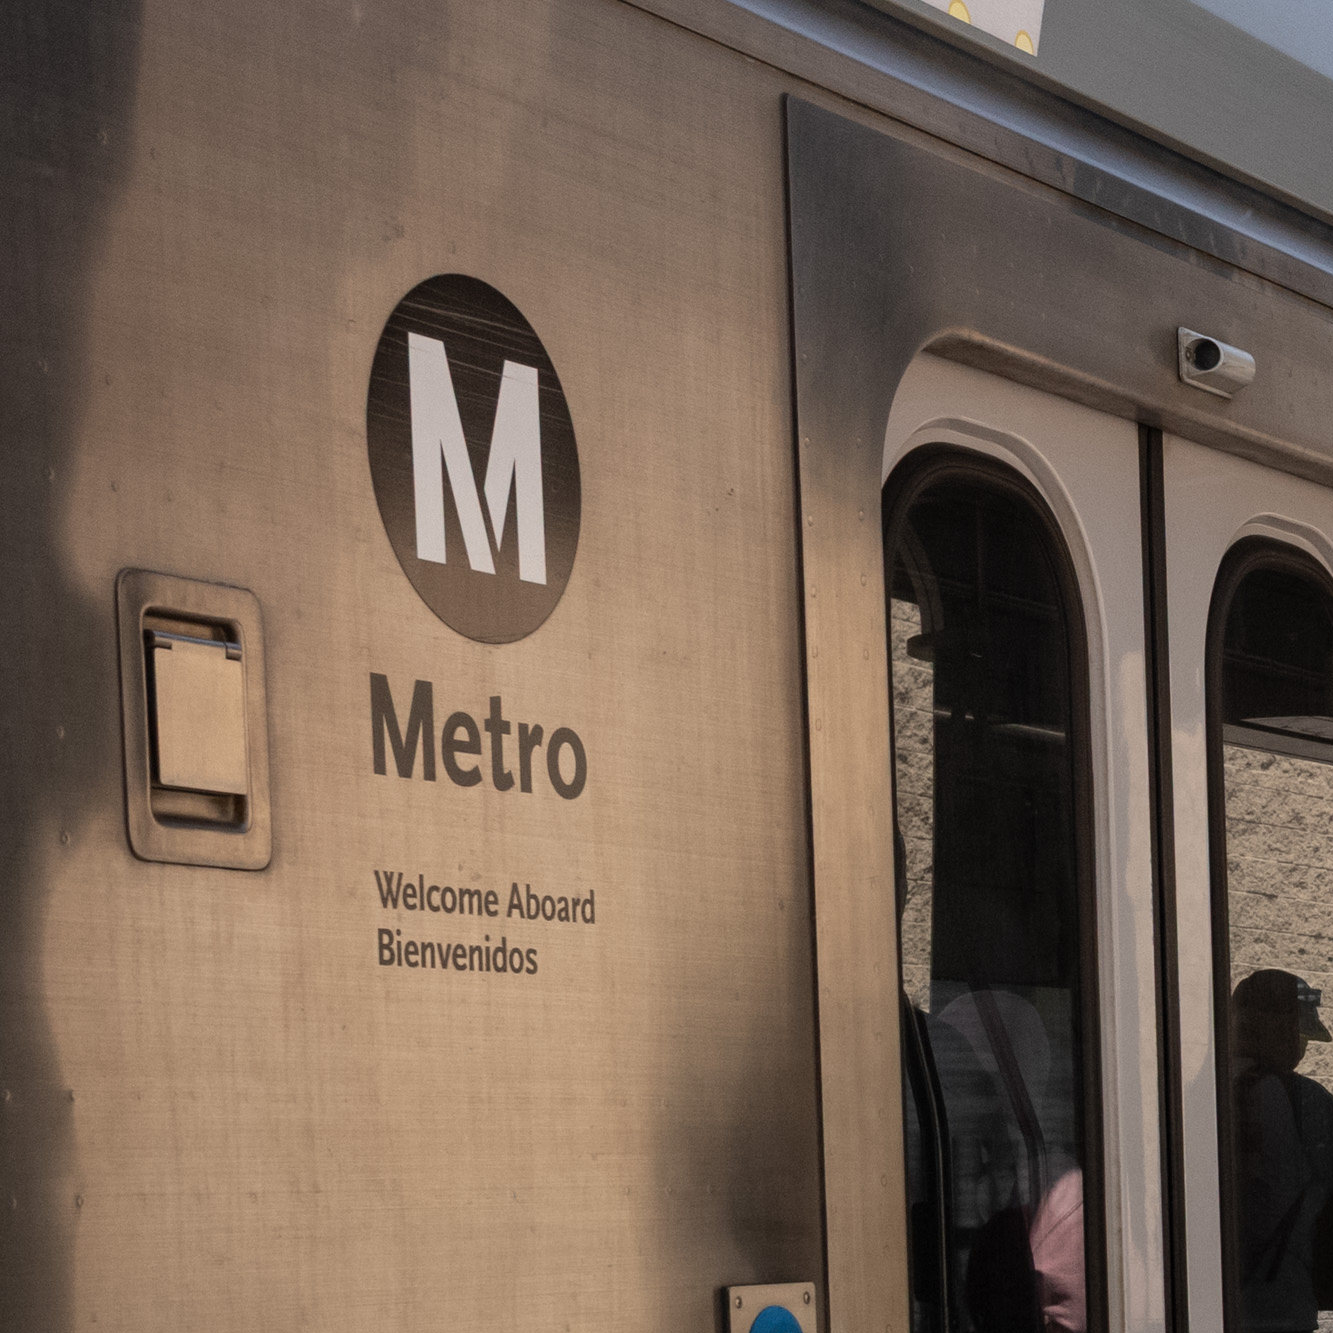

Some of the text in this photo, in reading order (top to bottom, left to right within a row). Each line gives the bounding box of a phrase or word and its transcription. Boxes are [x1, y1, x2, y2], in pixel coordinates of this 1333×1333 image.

[408, 332, 547, 586] M
[369, 671, 588, 801] Metro
[373, 868, 596, 925] Welcome Aboard
[377, 927, 539, 976] Bienvenidos
